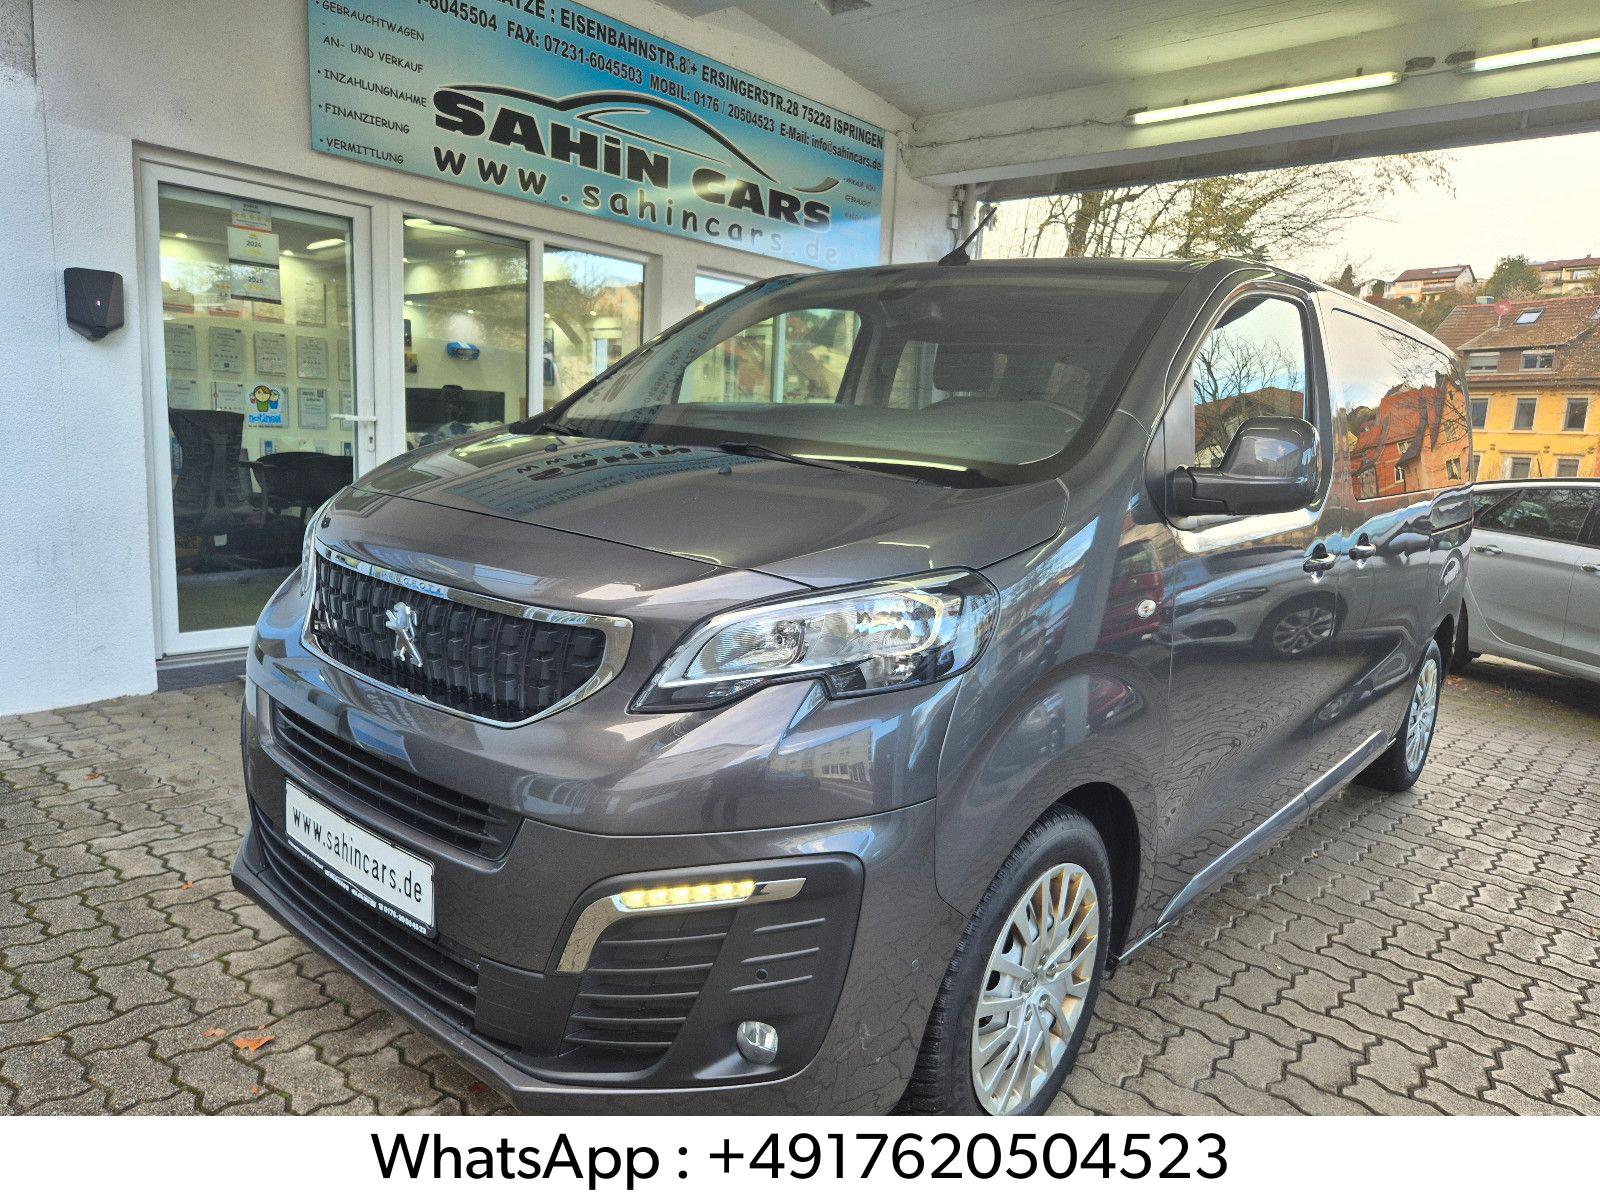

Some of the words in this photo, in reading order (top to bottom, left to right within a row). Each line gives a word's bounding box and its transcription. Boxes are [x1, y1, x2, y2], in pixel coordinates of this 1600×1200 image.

[322, 0, 425, 42] GEBRAUCHTWAGEN
[323, 36, 345, 48] AN-
[350, 43, 374, 59] UND
[378, 52, 424, 74] VERKAUF
[324, 68, 427, 108] INZAHLUNGNAHME
[507, 20, 539, 47] FAX:
[544, 35, 643, 85] 07231-6045503
[650, 73, 690, 103] MOBIL:
[693, 90, 719, 113] 0176
[728, 103, 775, 133] 20504523
[780, 123, 810, 146] E-Mail:
[811, 134, 882, 170] info@sahincars.de
[702, 65, 799, 117] ERSINGERSTR.28
[802, 105, 831, 130] 75228
[833, 117, 883, 150] ISPRINGEN
[325, 103, 410, 134] FINANZIERUNG
[326, 137, 404, 165] VERMITTLUNG
[691, 168, 832, 231] CARS
[292, 807, 422, 903] www.sahincars.de
